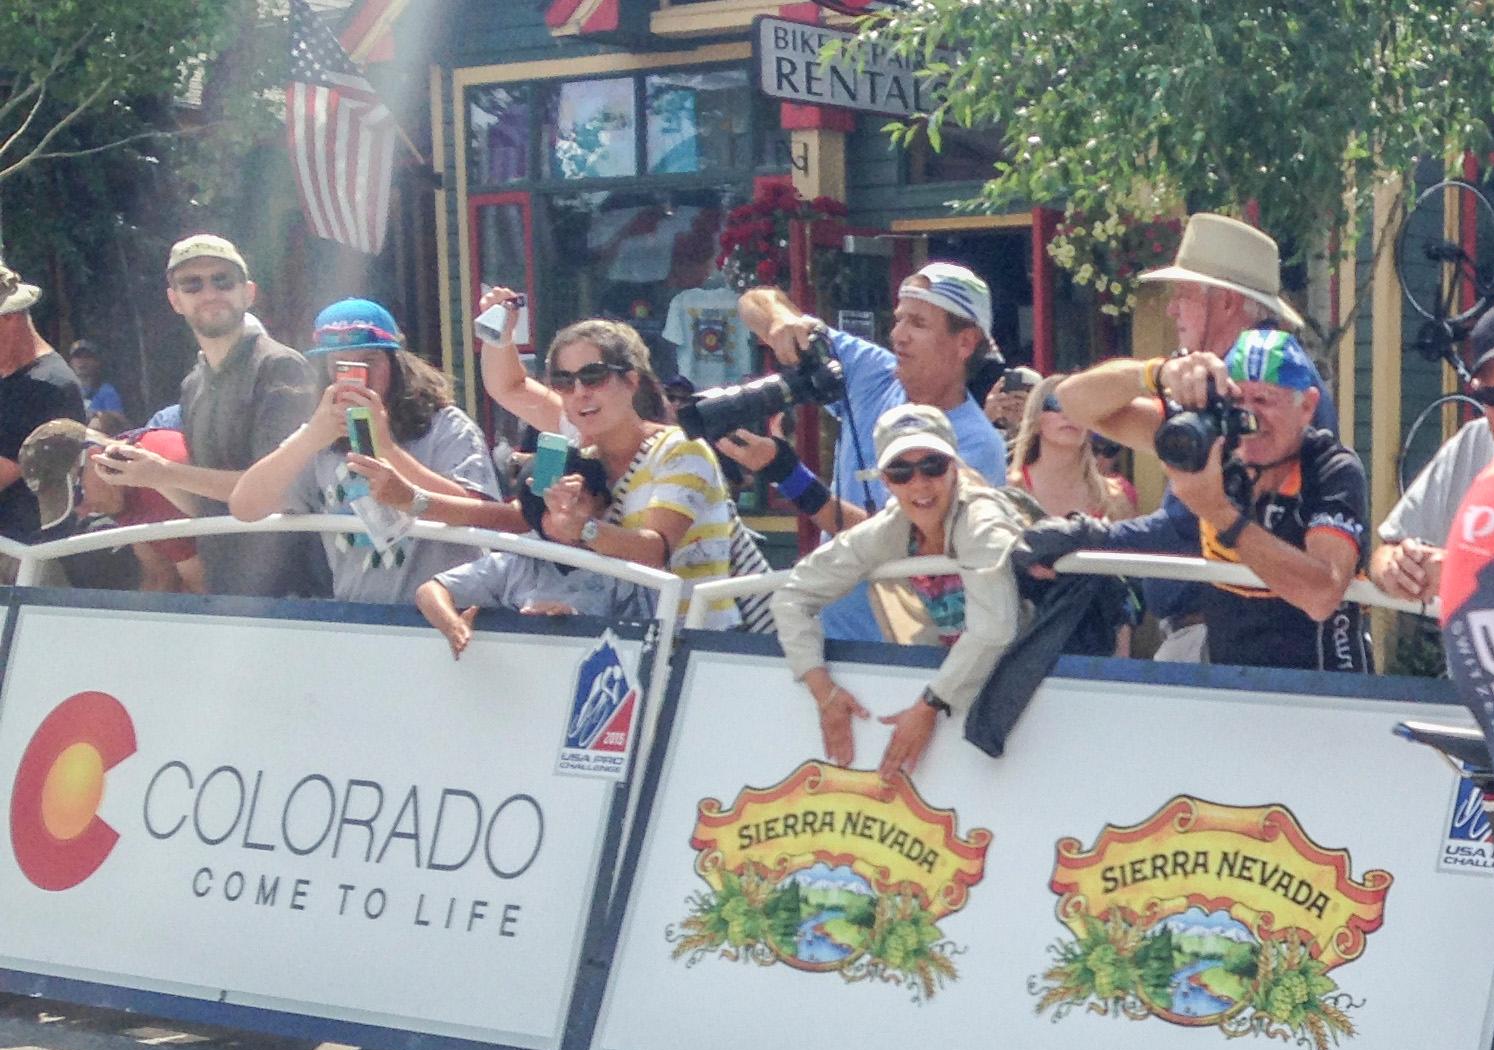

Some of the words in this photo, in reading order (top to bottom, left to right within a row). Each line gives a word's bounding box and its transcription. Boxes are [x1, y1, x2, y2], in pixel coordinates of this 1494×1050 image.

[774, 26, 829, 55] BIKE
[559, 761, 622, 774] CHALLENGE
[560, 751, 591, 763] USA
[592, 754, 625, 766] PRO
[143, 760, 545, 879] COLORADO
[737, 808, 836, 852] SIERRA
[839, 809, 942, 875] NEVADA
[1445, 845, 1486, 858] USA
[192, 867, 311, 912] COME
[338, 884, 387, 920] TO
[415, 894, 522, 938] LIFE
[1100, 850, 1211, 894] SIERRA
[1214, 850, 1331, 920] NEVADA
